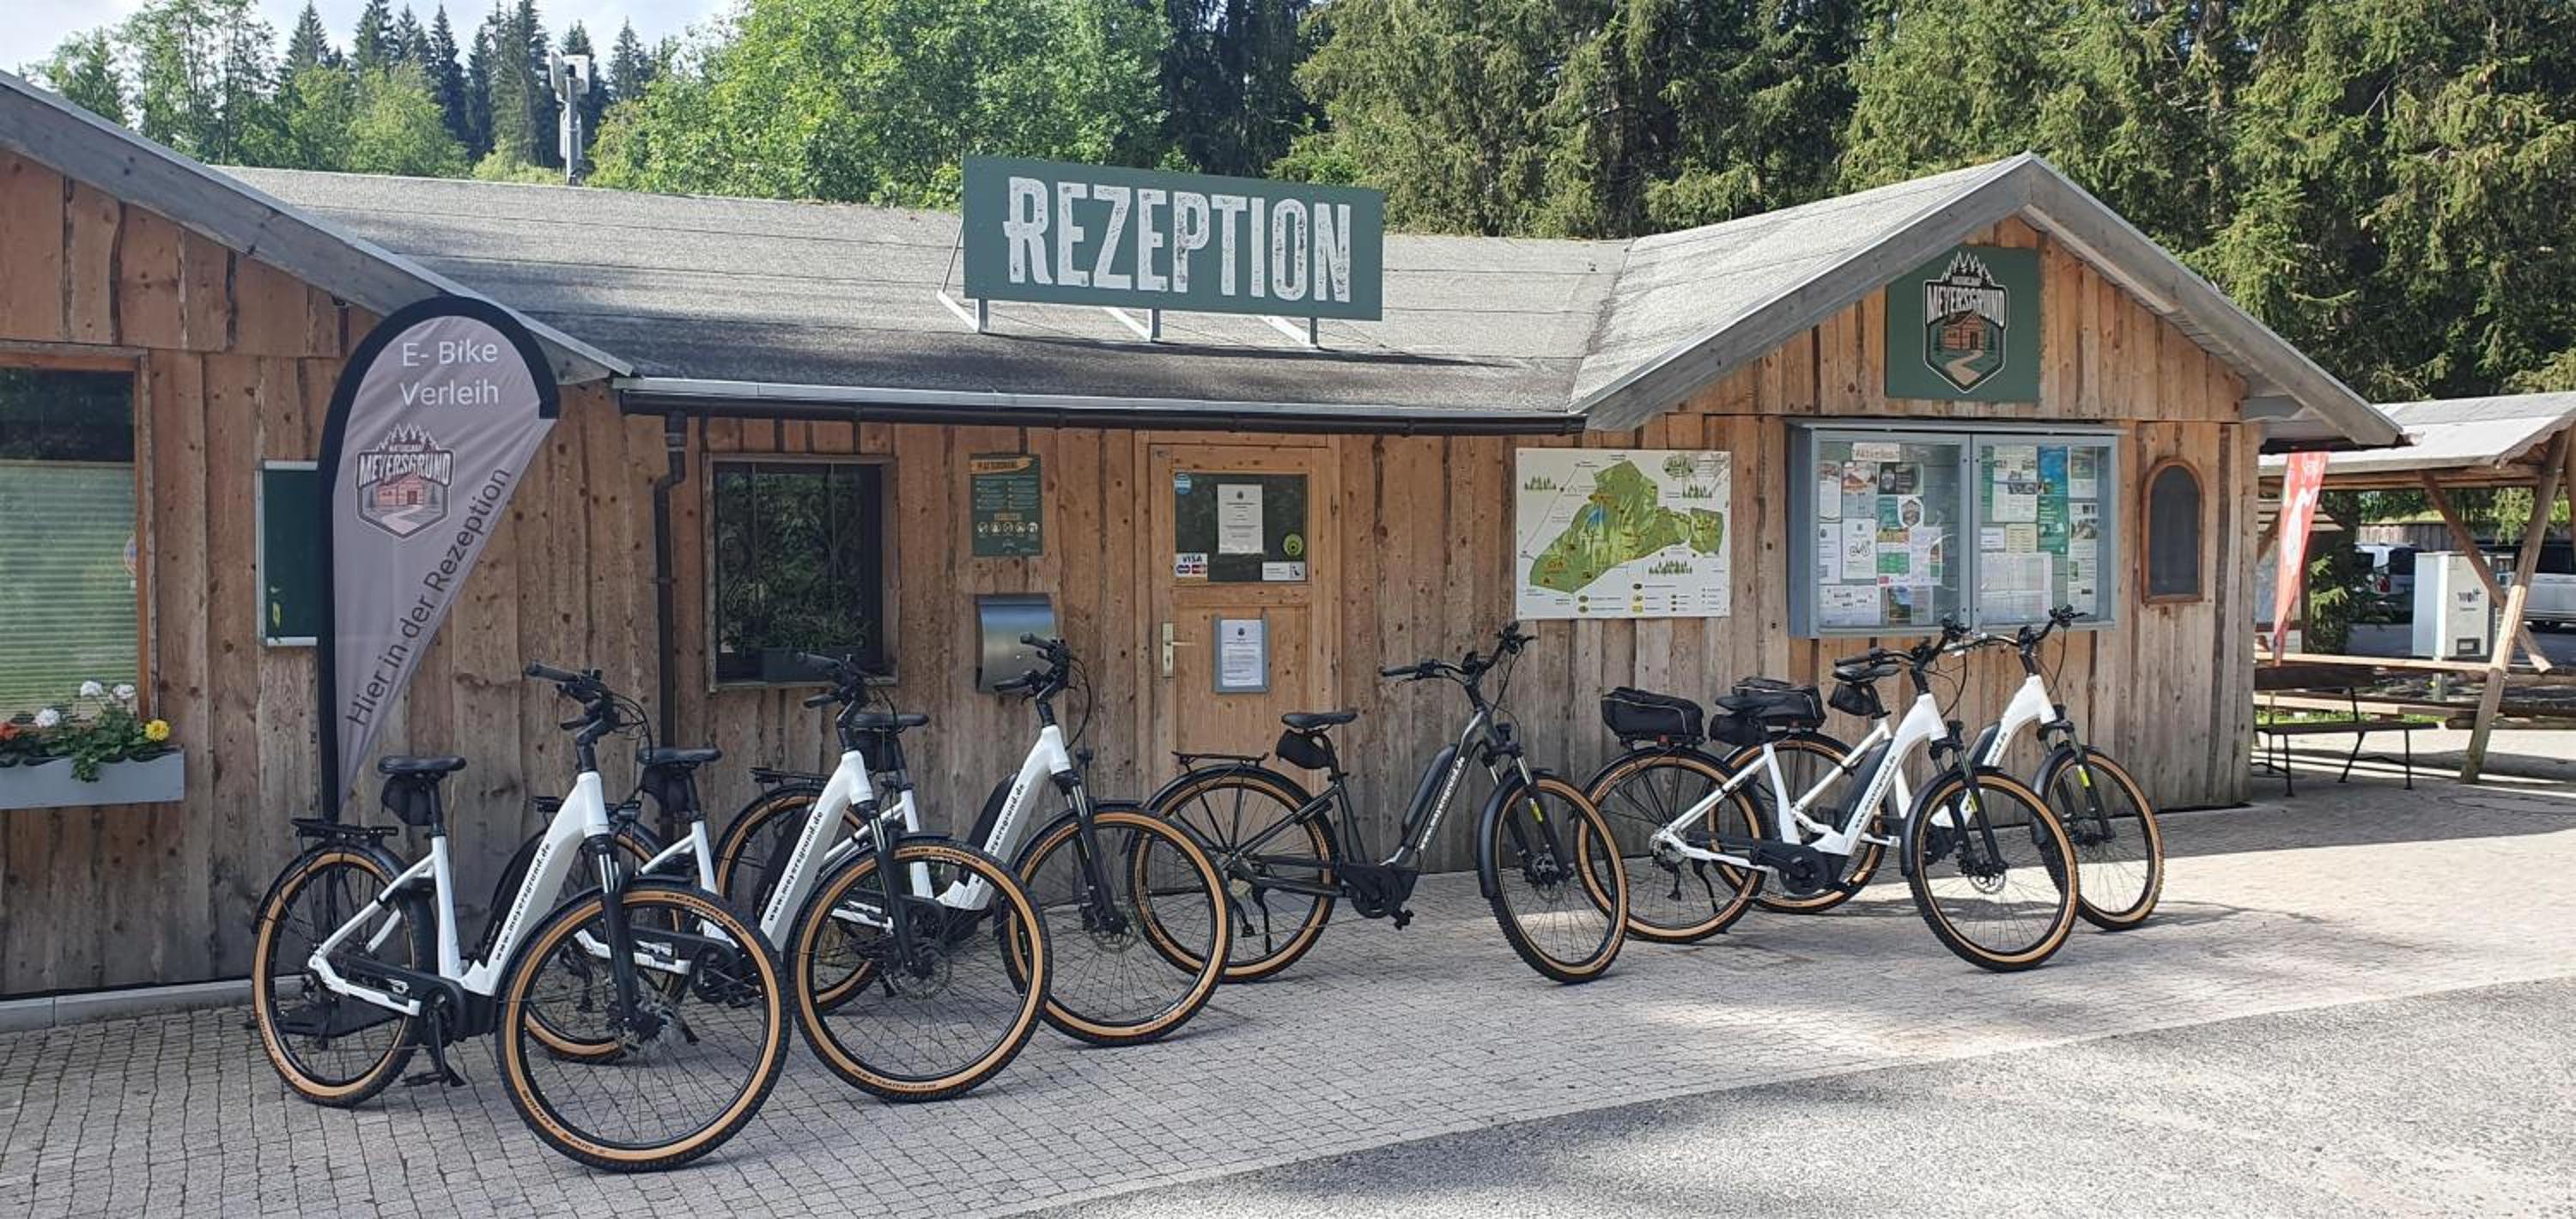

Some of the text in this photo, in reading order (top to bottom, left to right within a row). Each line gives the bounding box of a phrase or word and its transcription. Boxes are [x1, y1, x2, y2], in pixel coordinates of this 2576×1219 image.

[1003, 176, 1351, 303] REZEPTION
[1925, 284, 2005, 329] MEYERSGRUND
[402, 341, 499, 367] E- Bike
[400, 379, 500, 407] Verleih
[358, 452, 452, 488] MEYERSGRUND
[346, 466, 512, 729] Hier in der Rezeption
[495, 842, 550, 961] www.meyersgrund.de
[769, 811, 823, 921] www.meyersgrund.de
